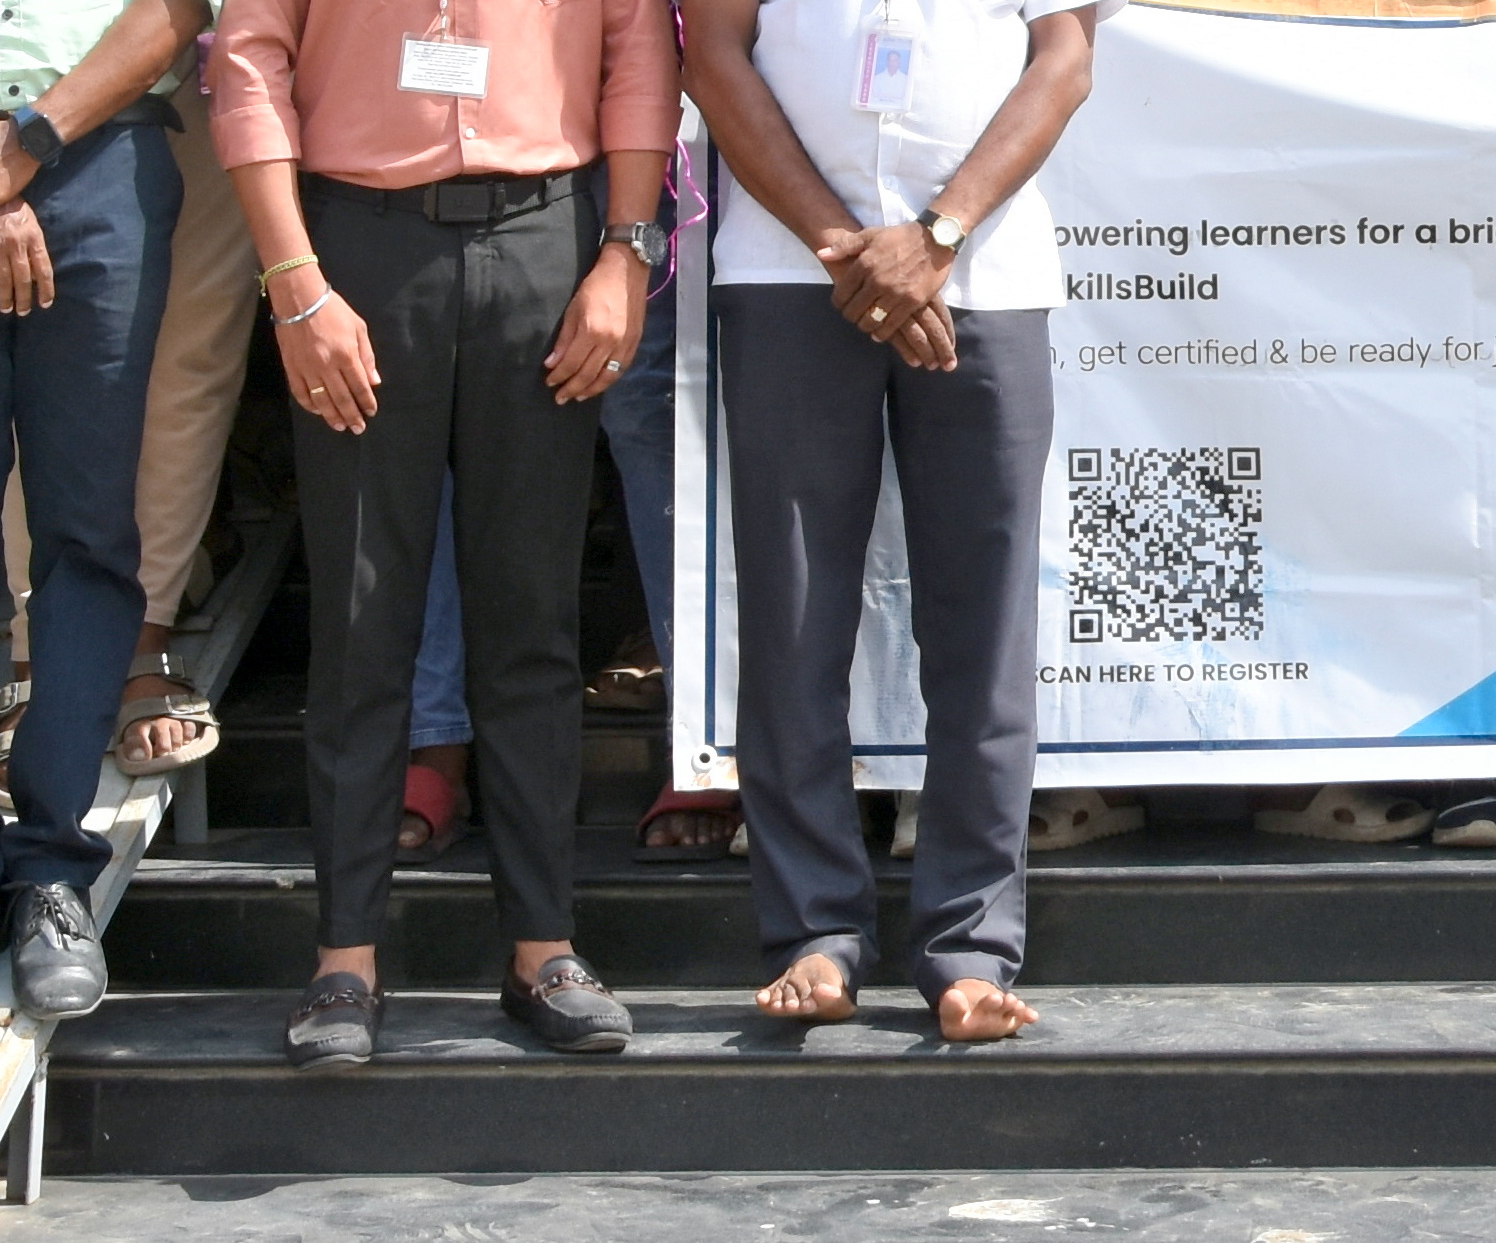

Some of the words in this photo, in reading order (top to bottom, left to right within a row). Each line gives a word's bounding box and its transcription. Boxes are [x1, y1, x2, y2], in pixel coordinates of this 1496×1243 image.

[1056, 218, 1189, 255] owering
[1201, 219, 1346, 247] learners
[1357, 217, 1405, 245] for
[1415, 224, 1437, 244] a
[1066, 272, 1219, 300] killsBuild
[1078, 341, 1126, 371] get
[1137, 339, 1257, 365] certified
[1270, 340, 1289, 364] &
[1301, 339, 1337, 364] be
[1349, 337, 1432, 368] ready
[1443, 336, 1483, 362] for
[1099, 664, 1155, 683] HERE
[1163, 664, 1194, 682] TO
[1203, 662, 1309, 682] REGISTER
